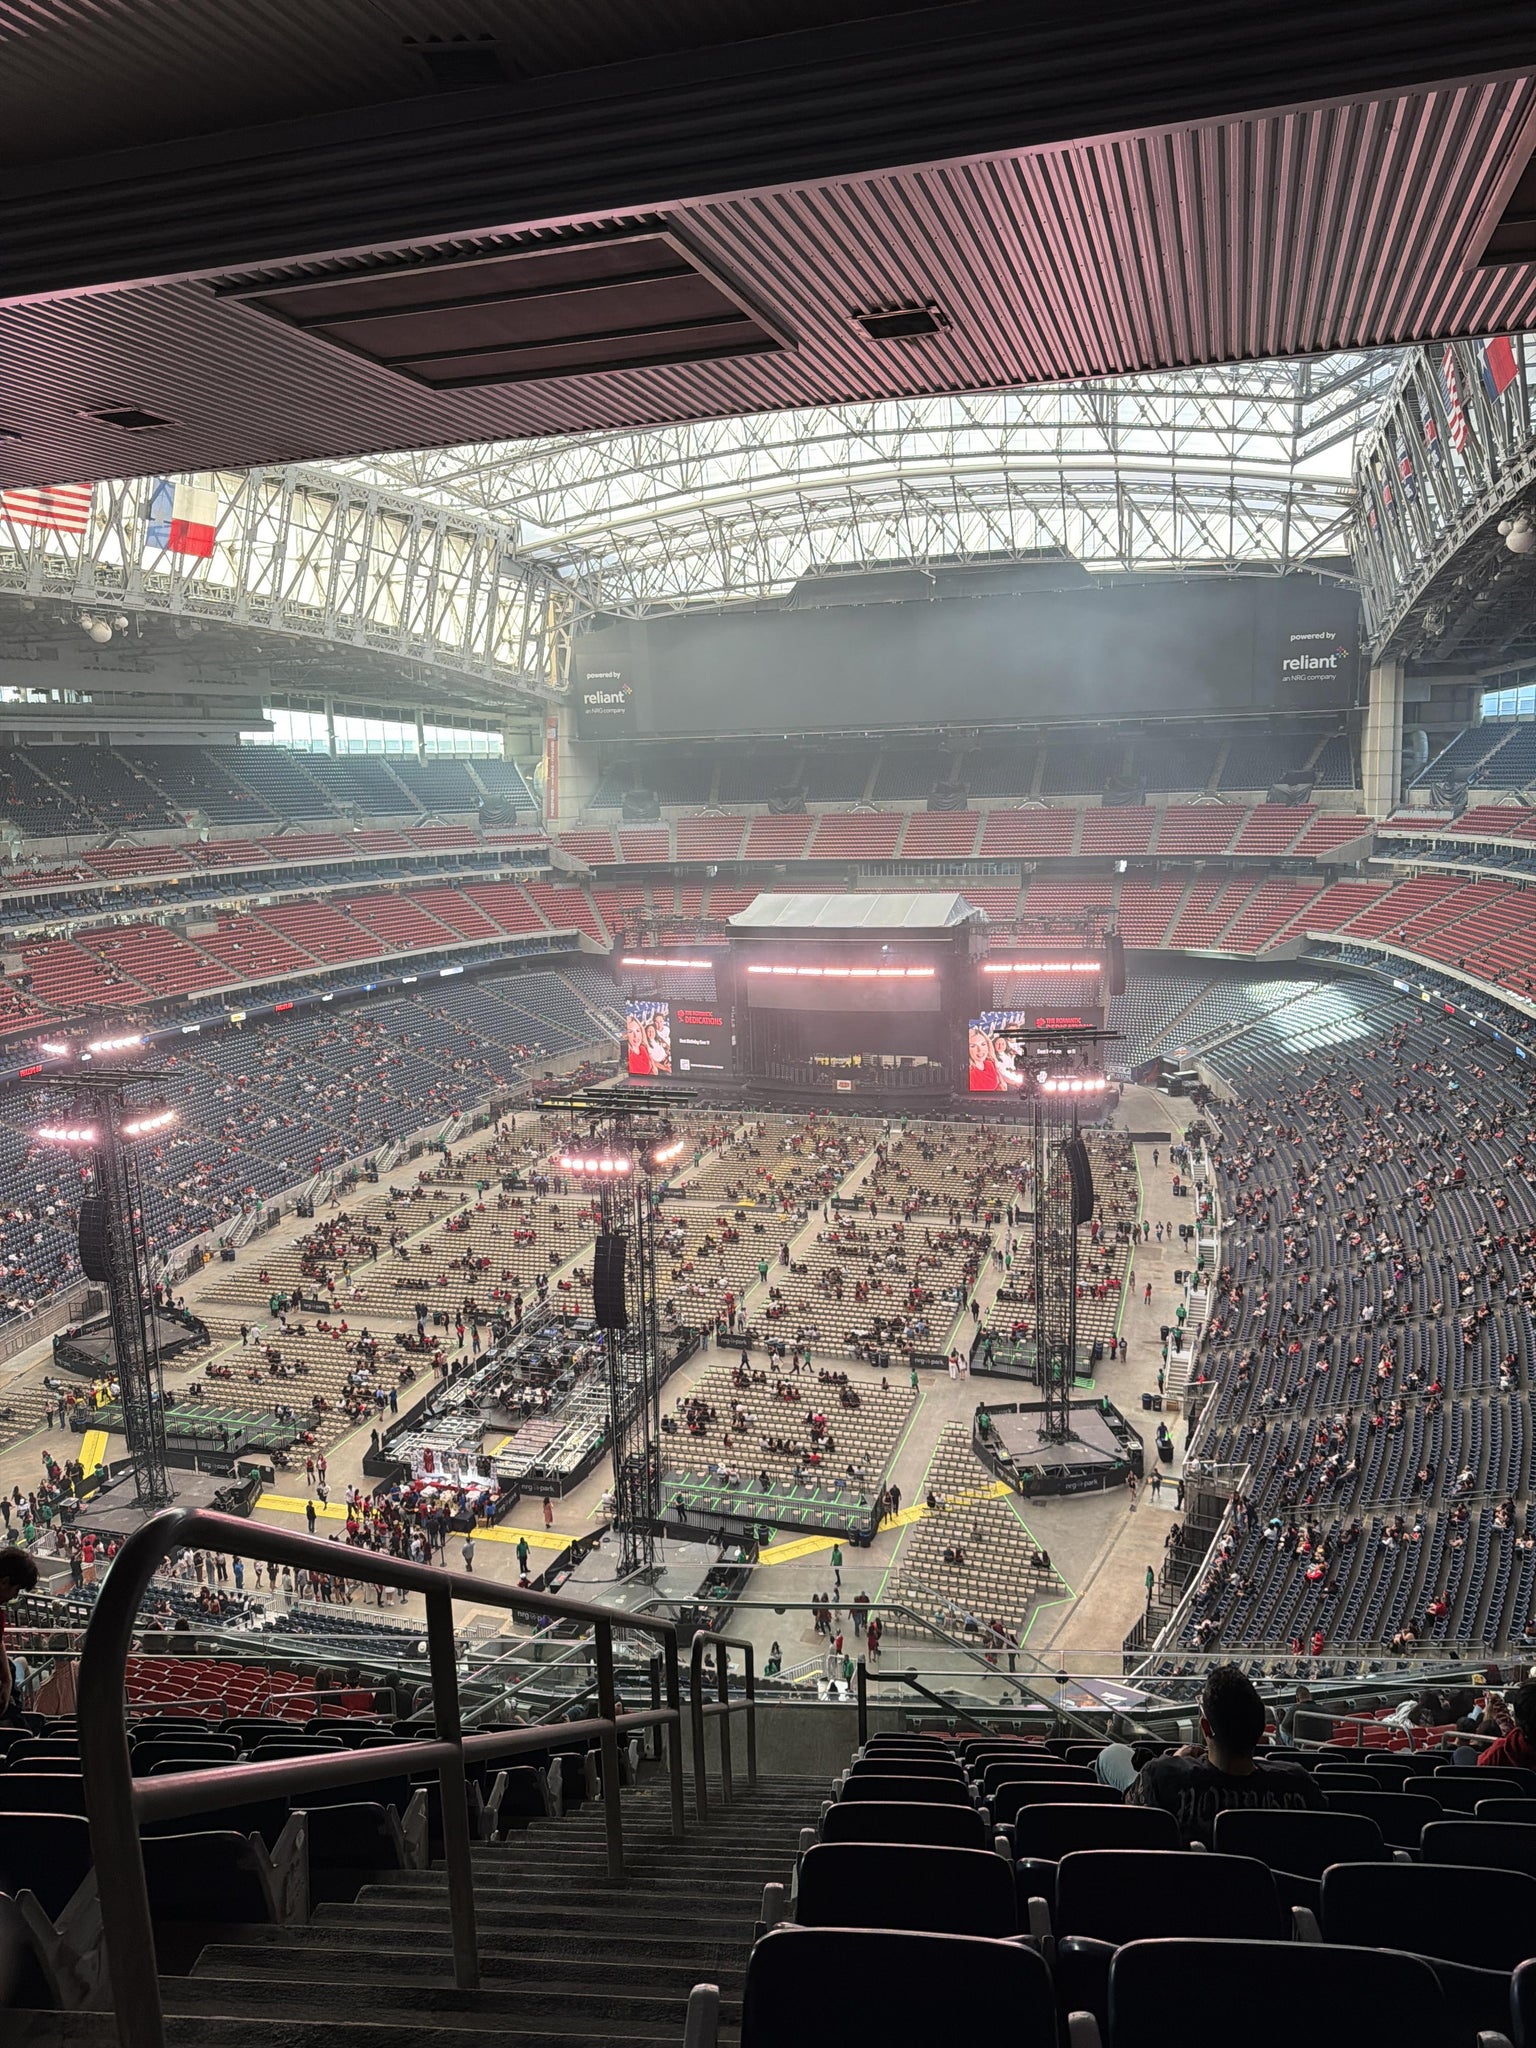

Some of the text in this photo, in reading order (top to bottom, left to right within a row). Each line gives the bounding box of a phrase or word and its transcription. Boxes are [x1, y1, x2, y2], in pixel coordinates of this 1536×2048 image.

[1290, 631, 1336, 642] powered by
[1282, 654, 1338, 671] reliant
[586, 671, 621, 680] powered by
[1306, 673, 1337, 681] company
[583, 690, 626, 704] reliant
[684, 1016, 723, 1026] DEDICATIONS
